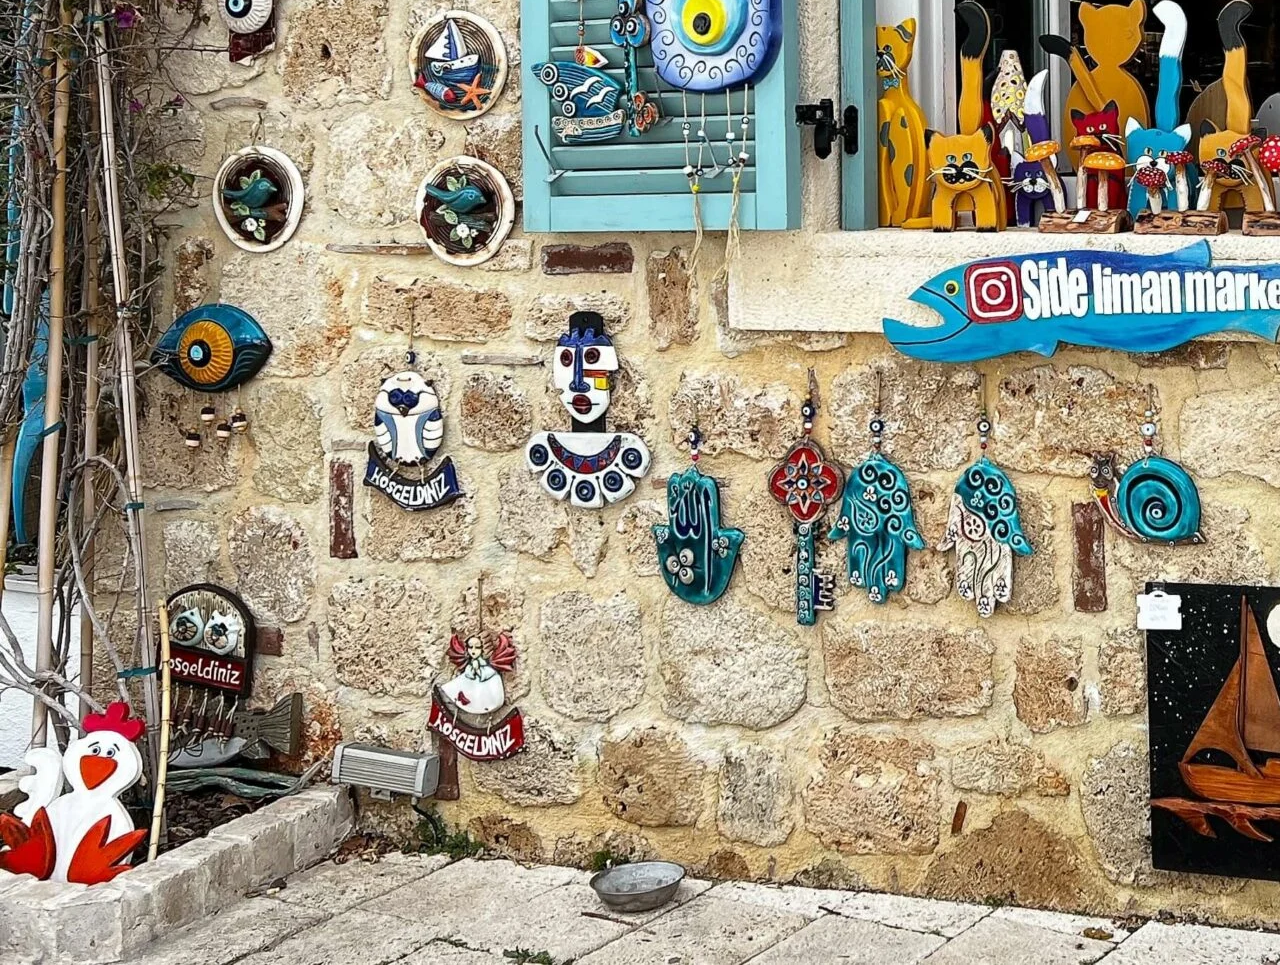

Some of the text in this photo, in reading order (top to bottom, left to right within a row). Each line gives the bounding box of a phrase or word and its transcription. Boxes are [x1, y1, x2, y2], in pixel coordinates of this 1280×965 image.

[1020, 257, 1090, 321] Side
[1092, 263, 1182, 315] liman
[159, 651, 241, 685] osgeldiniz
